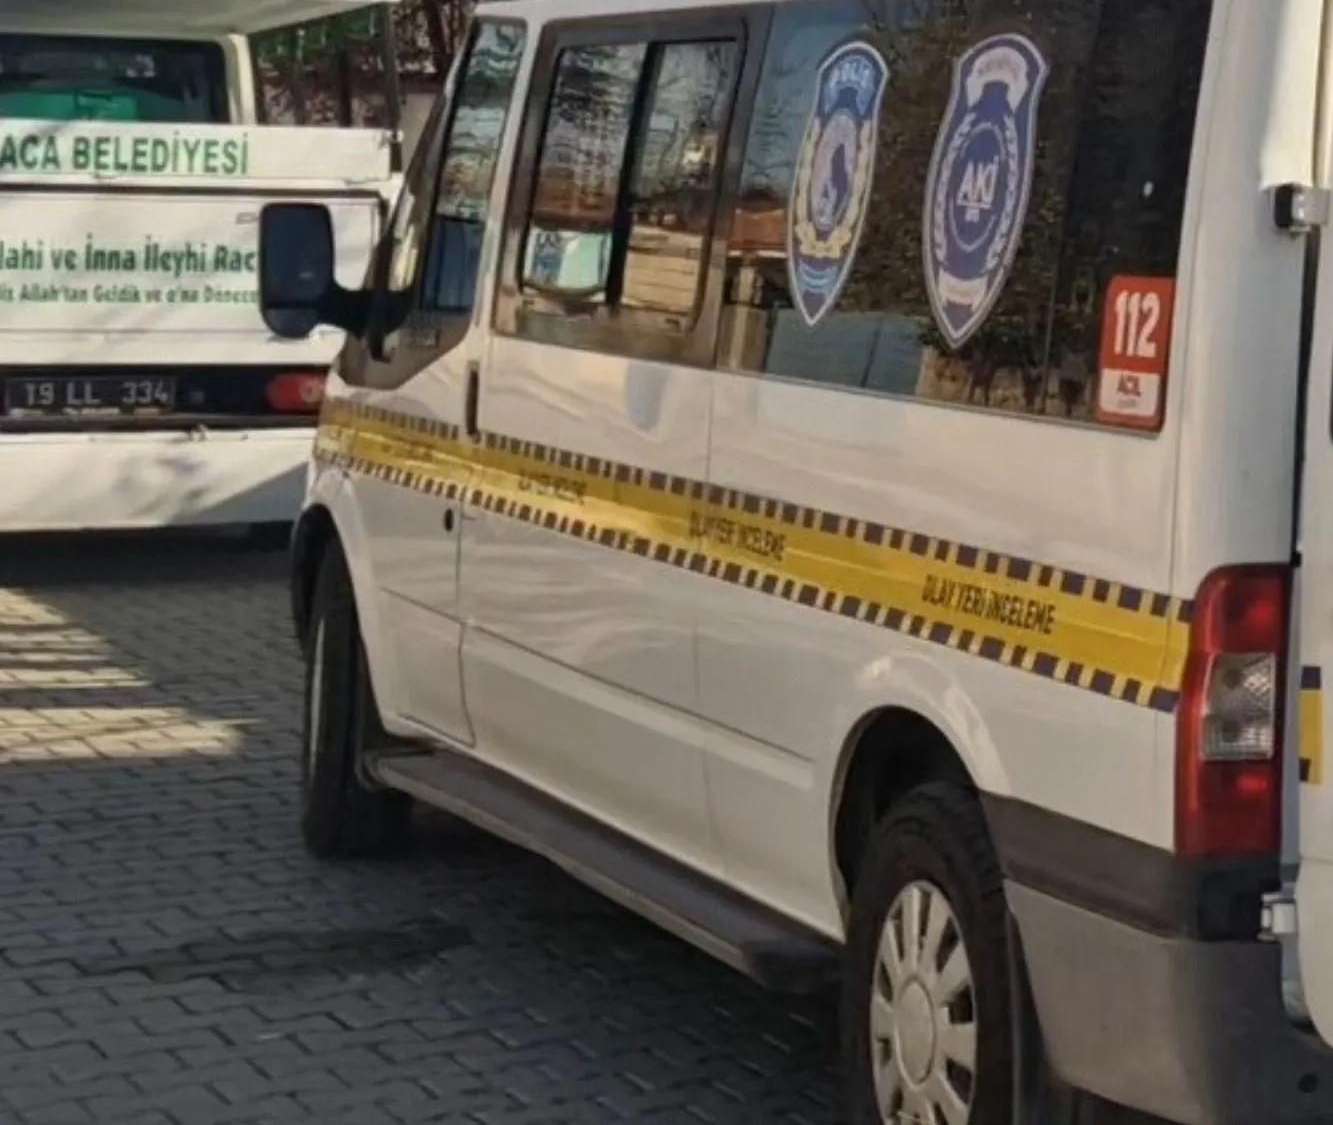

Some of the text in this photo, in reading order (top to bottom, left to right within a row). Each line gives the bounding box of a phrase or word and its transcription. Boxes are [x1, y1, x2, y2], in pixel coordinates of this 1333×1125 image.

[73, 130, 249, 175] BELEDİYESİ
[51, 248, 77, 270] ve
[1114, 290, 1160, 358] 112
[24, 380, 168, 405] 19 LL 334
